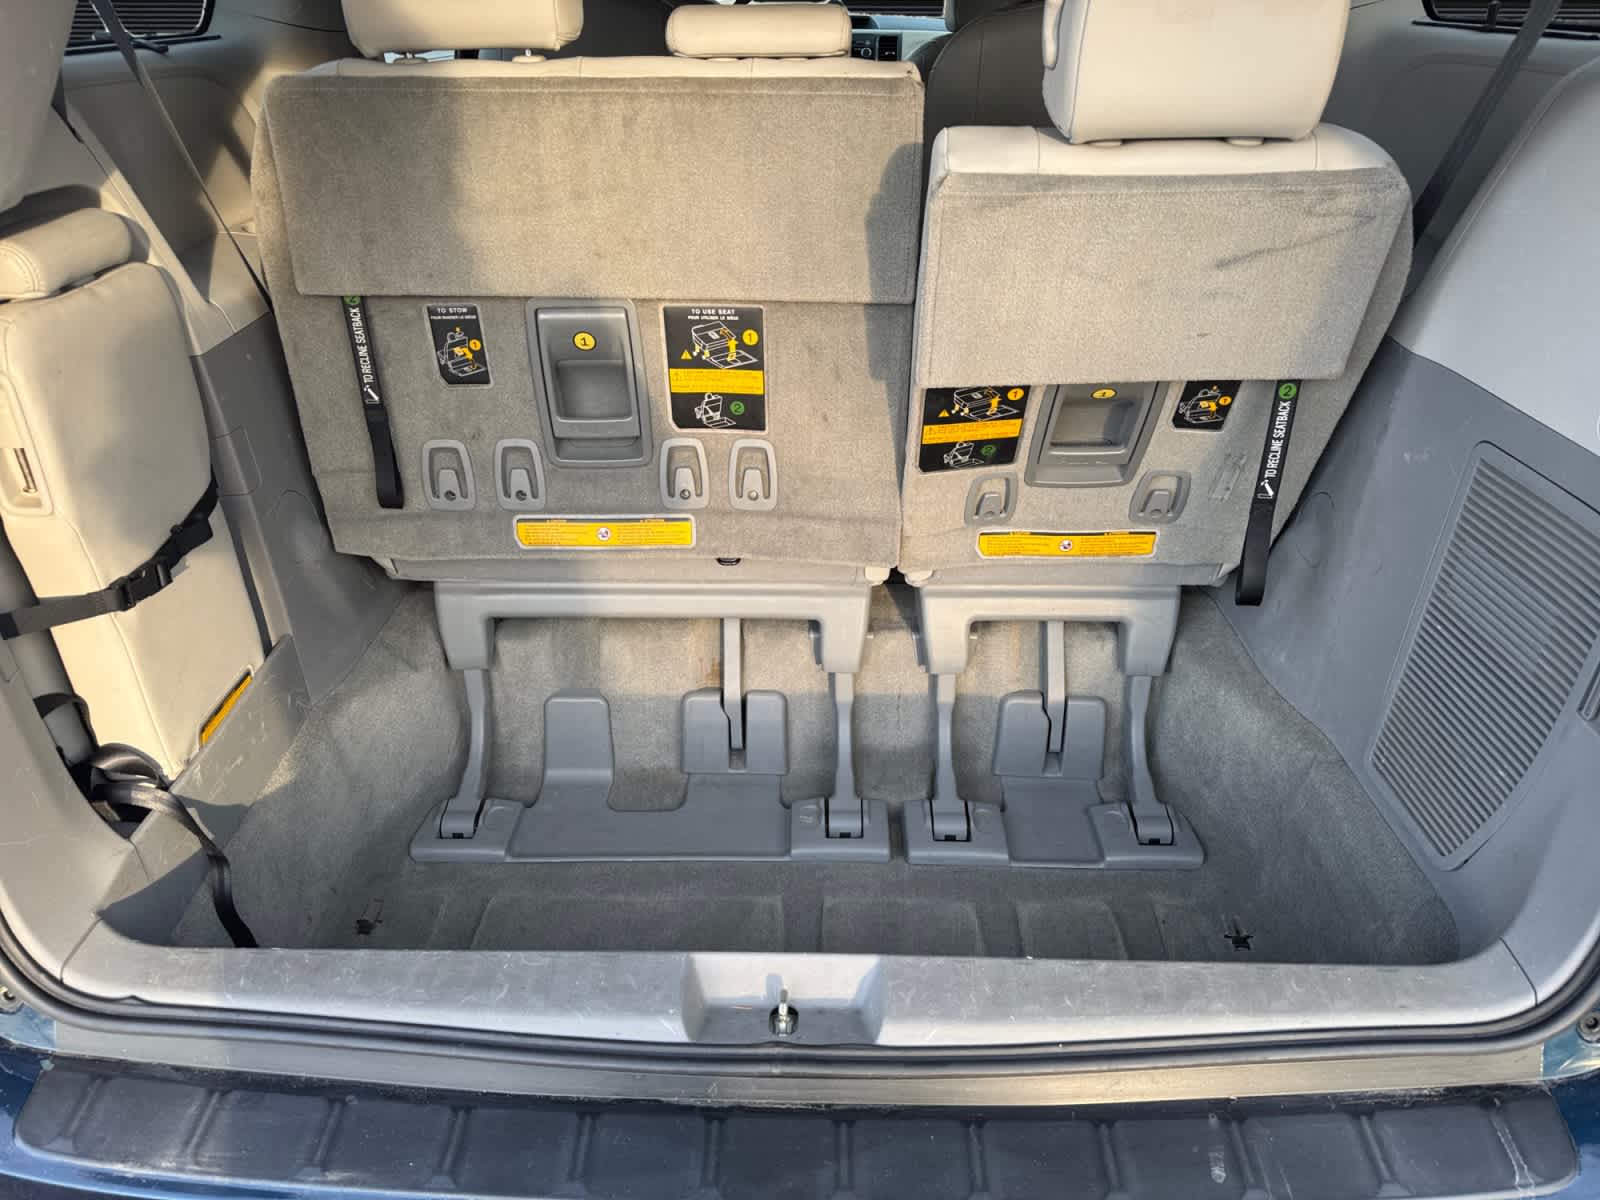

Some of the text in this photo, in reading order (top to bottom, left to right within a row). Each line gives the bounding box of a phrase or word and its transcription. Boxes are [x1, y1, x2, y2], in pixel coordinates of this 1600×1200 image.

[348, 307, 374, 383] TO RECLINE SEATBACK
[1264, 401, 1292, 478] TO RECLINE SEATBACK
